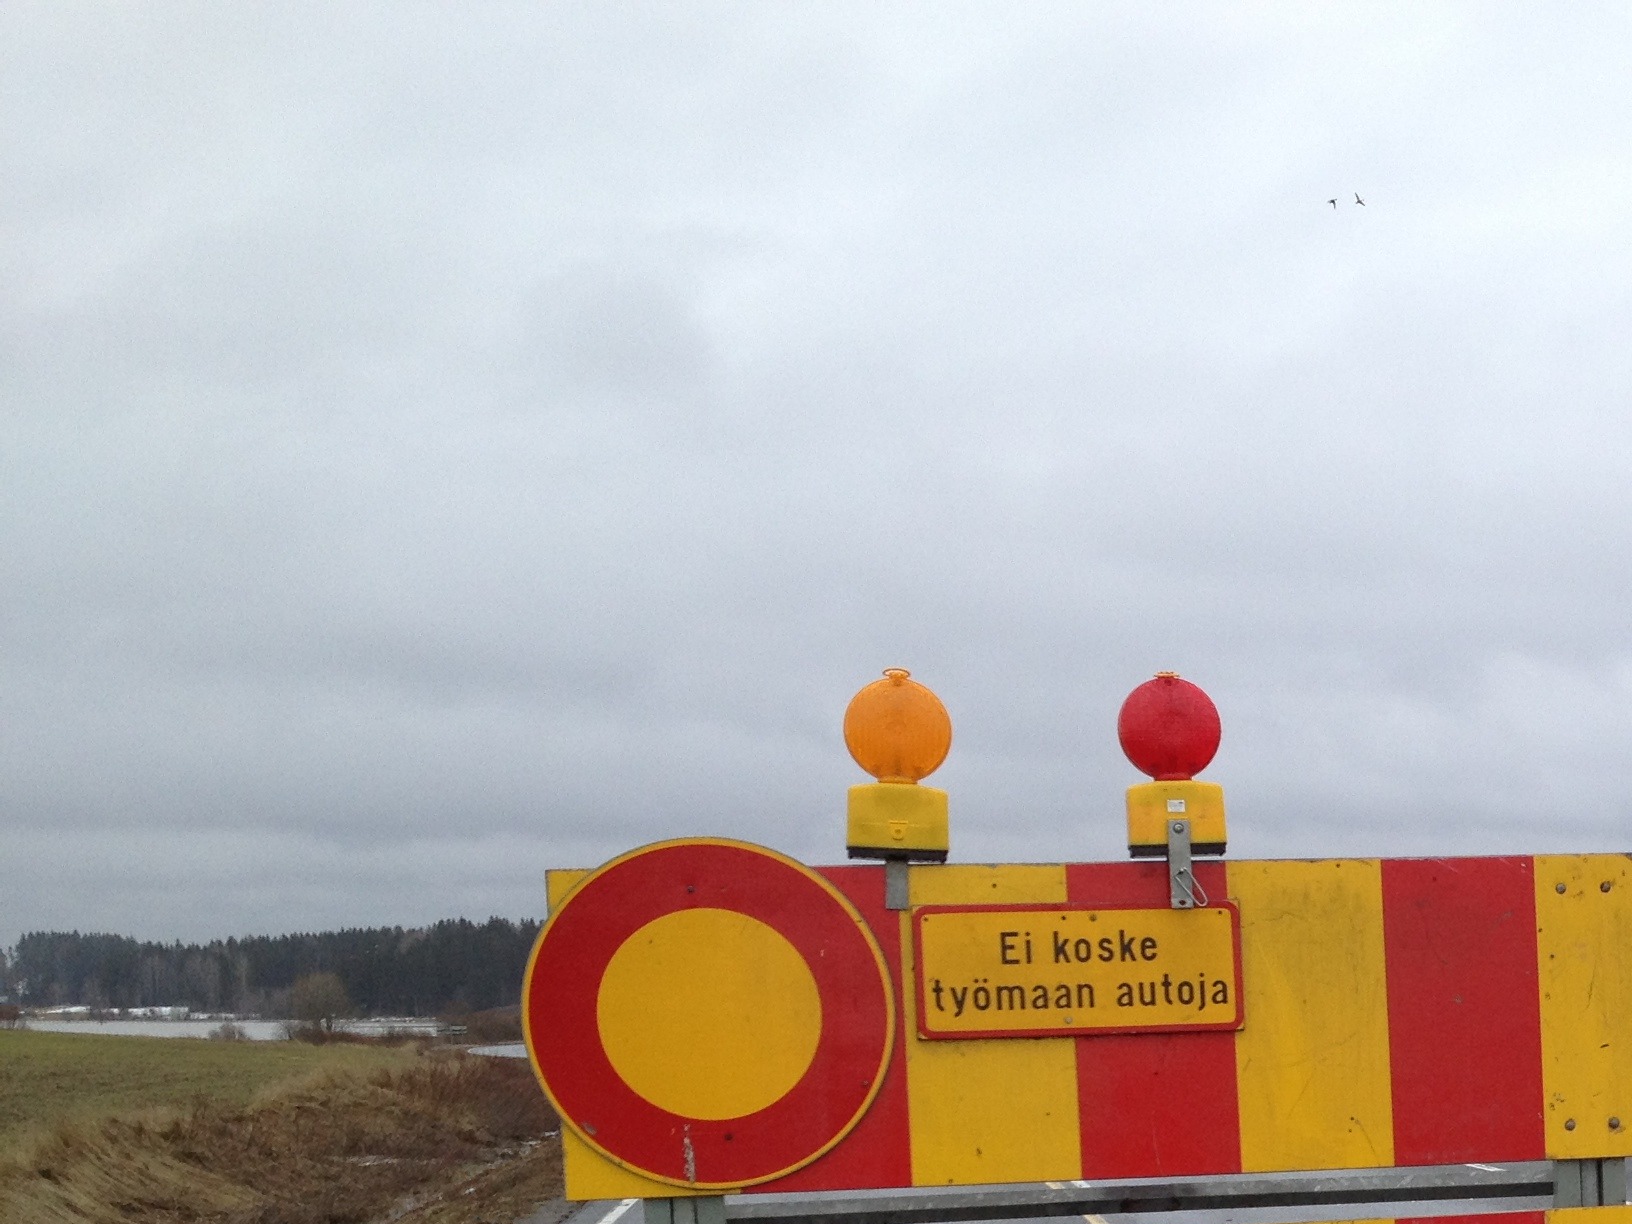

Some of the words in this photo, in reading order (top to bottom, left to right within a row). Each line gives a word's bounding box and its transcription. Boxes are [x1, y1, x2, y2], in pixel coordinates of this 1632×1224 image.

[1000, 931, 1032, 965] Ei
[1053, 929, 1158, 964] koske
[932, 978, 1095, 1018] työmaan
[1116, 972, 1228, 1011] autoja
